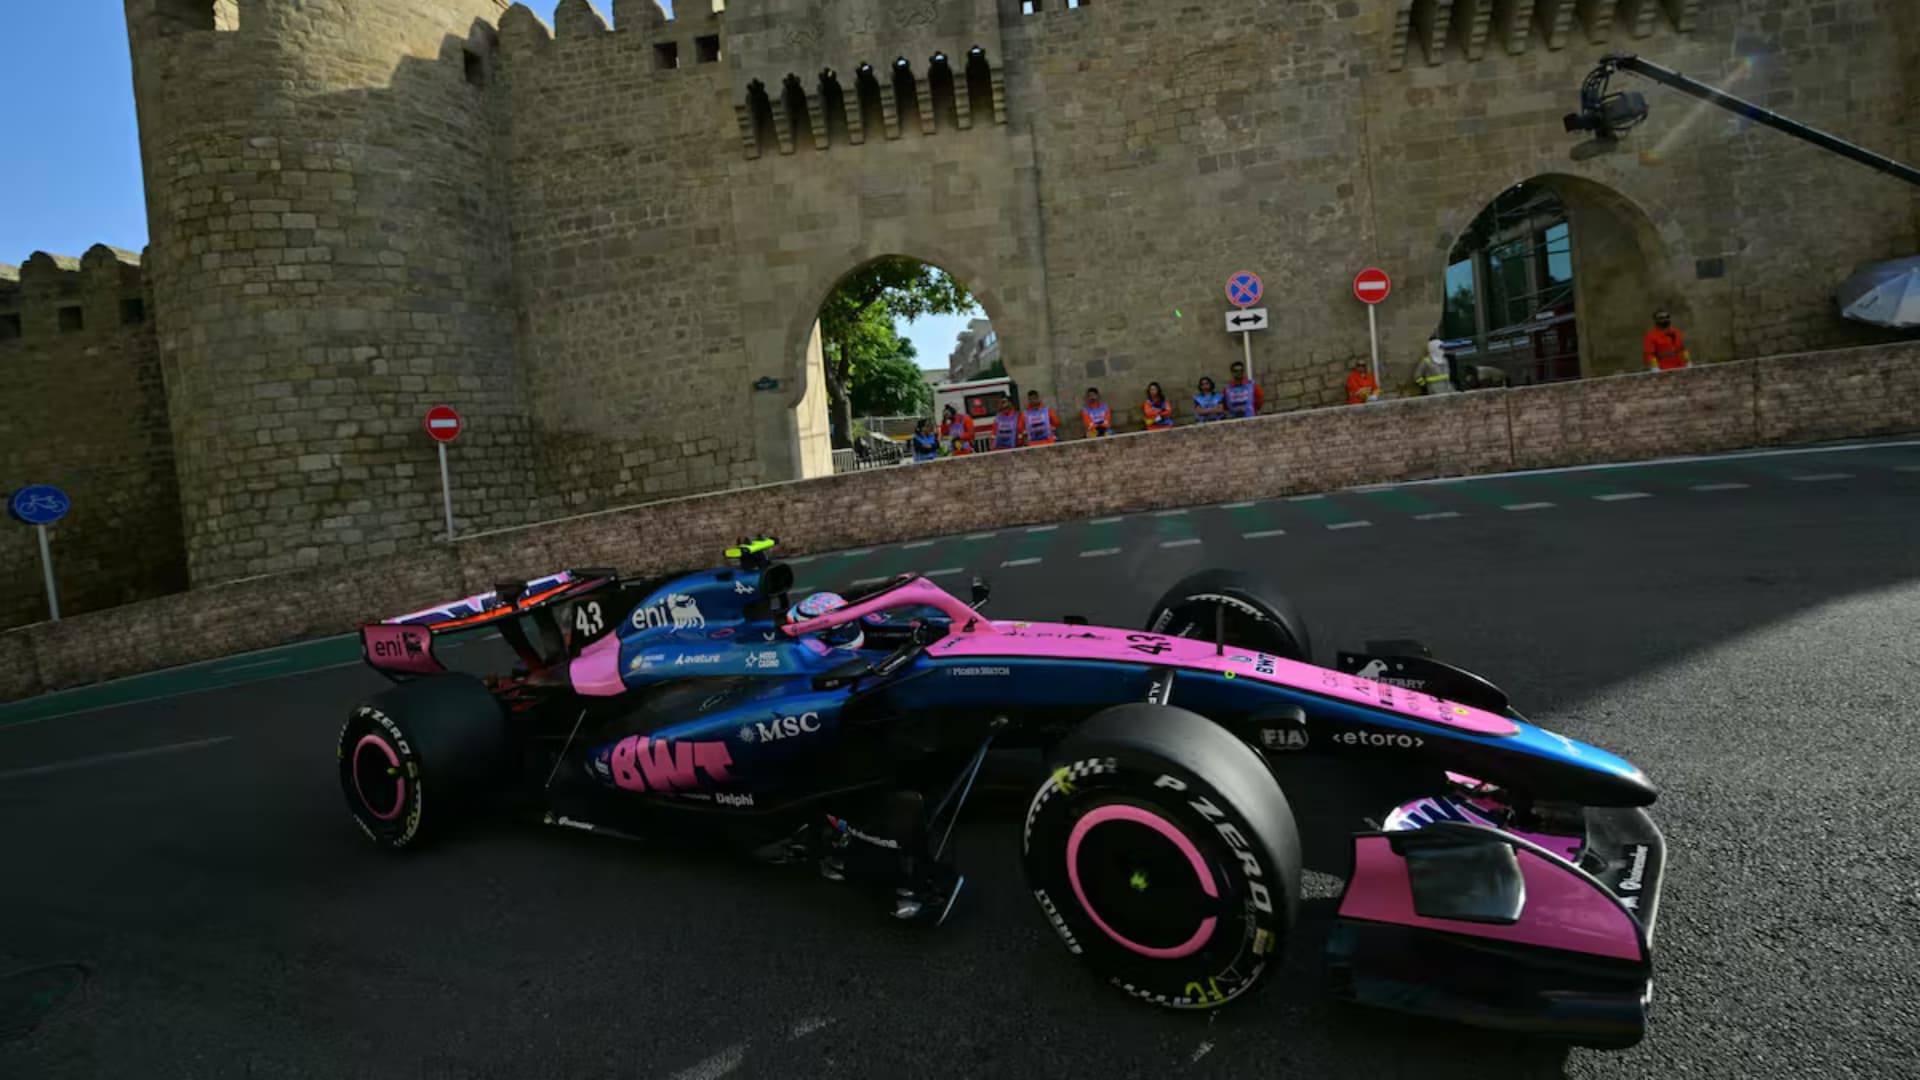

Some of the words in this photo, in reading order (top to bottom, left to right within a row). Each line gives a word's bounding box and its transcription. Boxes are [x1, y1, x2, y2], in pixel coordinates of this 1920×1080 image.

[576, 601, 604, 637] 43
[632, 599, 667, 630] eni
[375, 633, 401, 657] eni
[1126, 634, 1172, 656] 43
[1256, 652, 1277, 676] BWT
[755, 711, 821, 743] MSC
[1261, 728, 1305, 745] FIA
[610, 734, 733, 792] BWT
[715, 793, 754, 808] Delphi
[1154, 774, 1188, 792] P
[1187, 795, 1273, 914] ZERO
